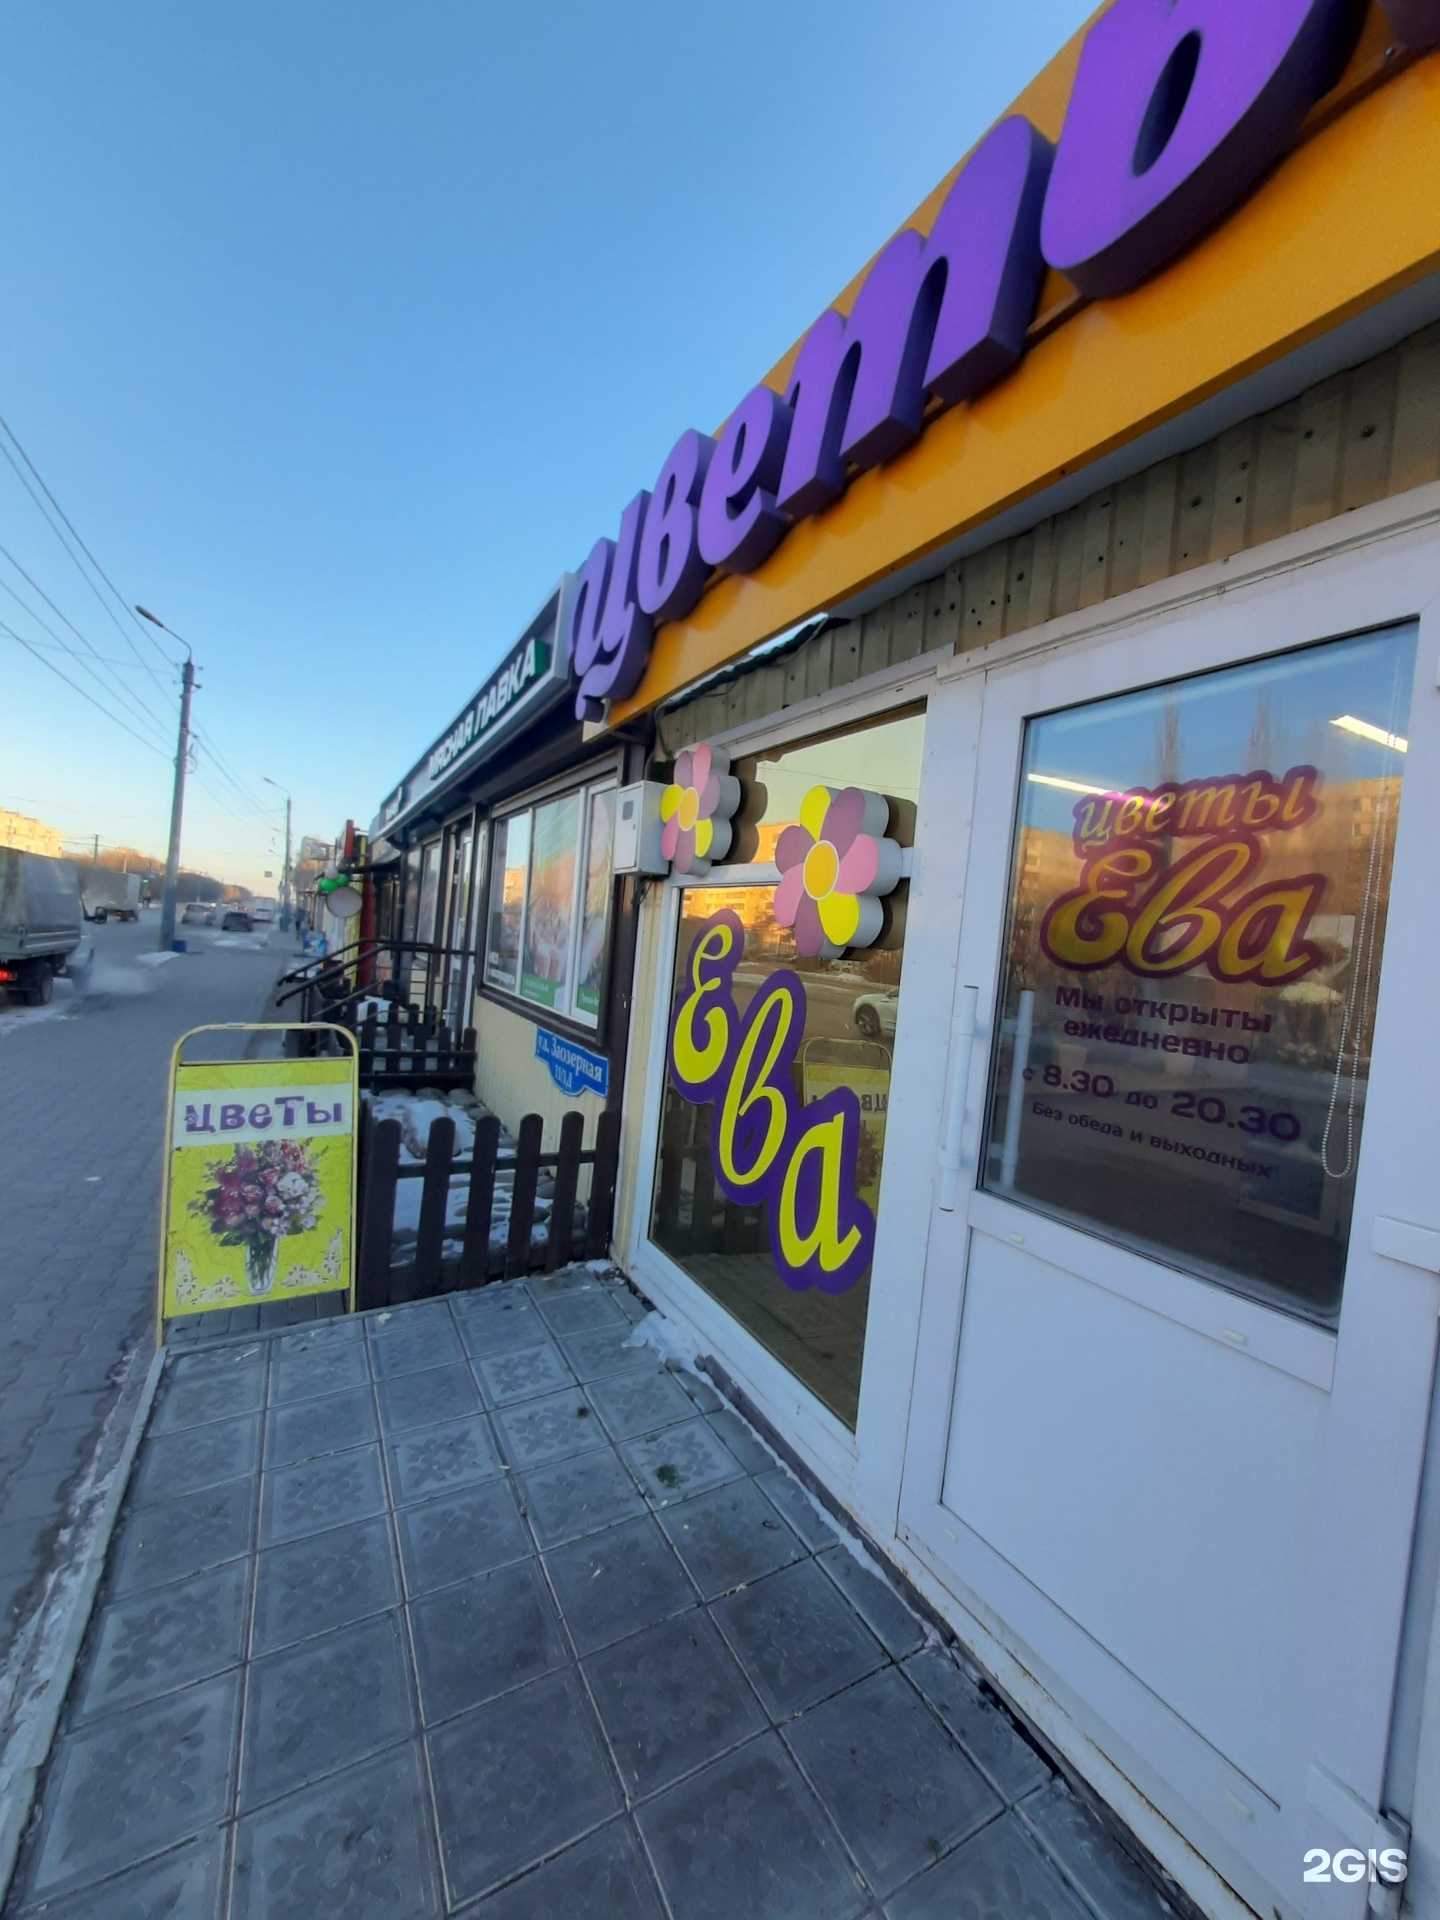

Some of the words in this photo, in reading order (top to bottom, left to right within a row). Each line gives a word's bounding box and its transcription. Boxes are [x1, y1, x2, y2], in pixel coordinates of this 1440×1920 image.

[474, 637, 536, 736] ЛАВКА
[1078, 776, 1306, 853] цветы
[1046, 841, 1317, 979] Ева
[1055, 985, 1105, 1012] Мы
[1114, 996, 1272, 1034] открыты
[1063, 1018, 1251, 1065] ежедневно
[672, 922, 863, 1273] Ева
[1042, 1064, 1115, 1099] 8.30
[1125, 1090, 1159, 1110] до
[1171, 1090, 1301, 1142] 20.30
[1032, 1101, 1063, 1122] Без
[1068, 1113, 1124, 1138] обеда
[1129, 1128, 1144, 1144] и
[1150, 1134, 1272, 1179] выходных
